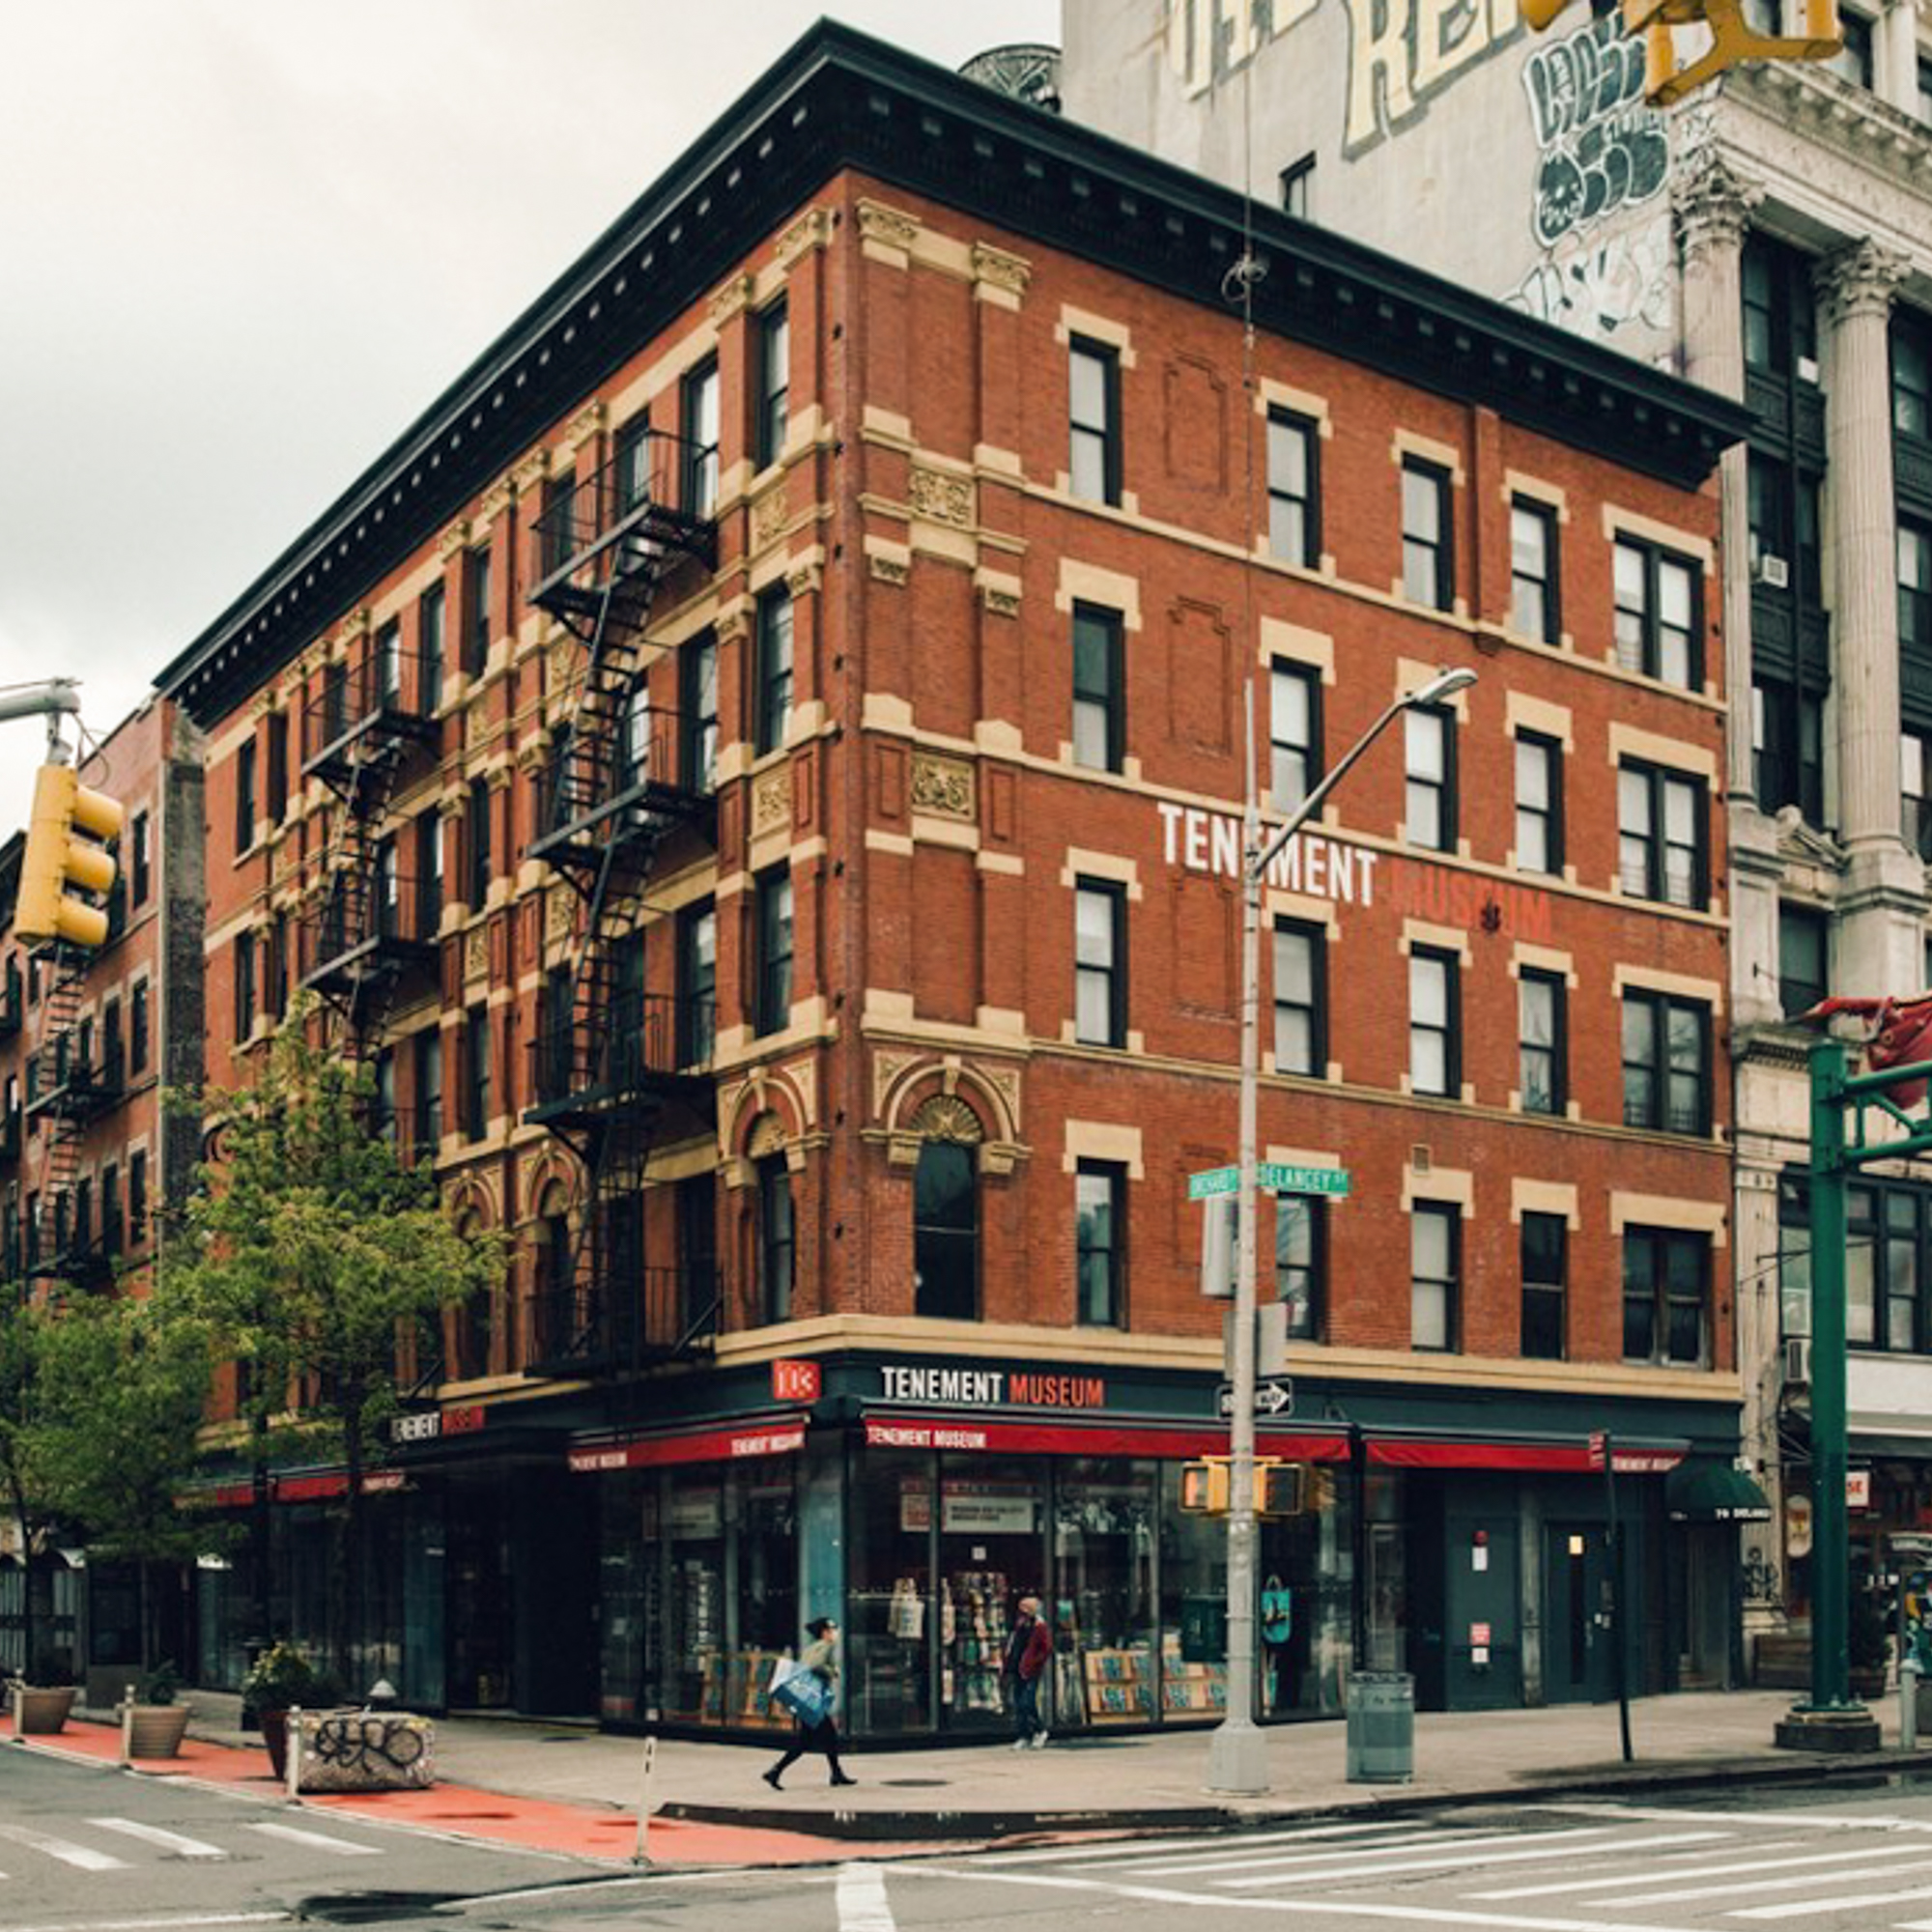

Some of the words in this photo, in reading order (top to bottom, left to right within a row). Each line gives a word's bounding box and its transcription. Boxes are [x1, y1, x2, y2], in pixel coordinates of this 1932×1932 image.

[1157, 802, 1377, 907] TENMENT
[882, 1366, 1004, 1403] TENEMENT
[1009, 1374, 1104, 1406] MUSEUM
[867, 1426, 930, 1446] TENEMENT
[933, 1430, 985, 1448] MUSEUM
